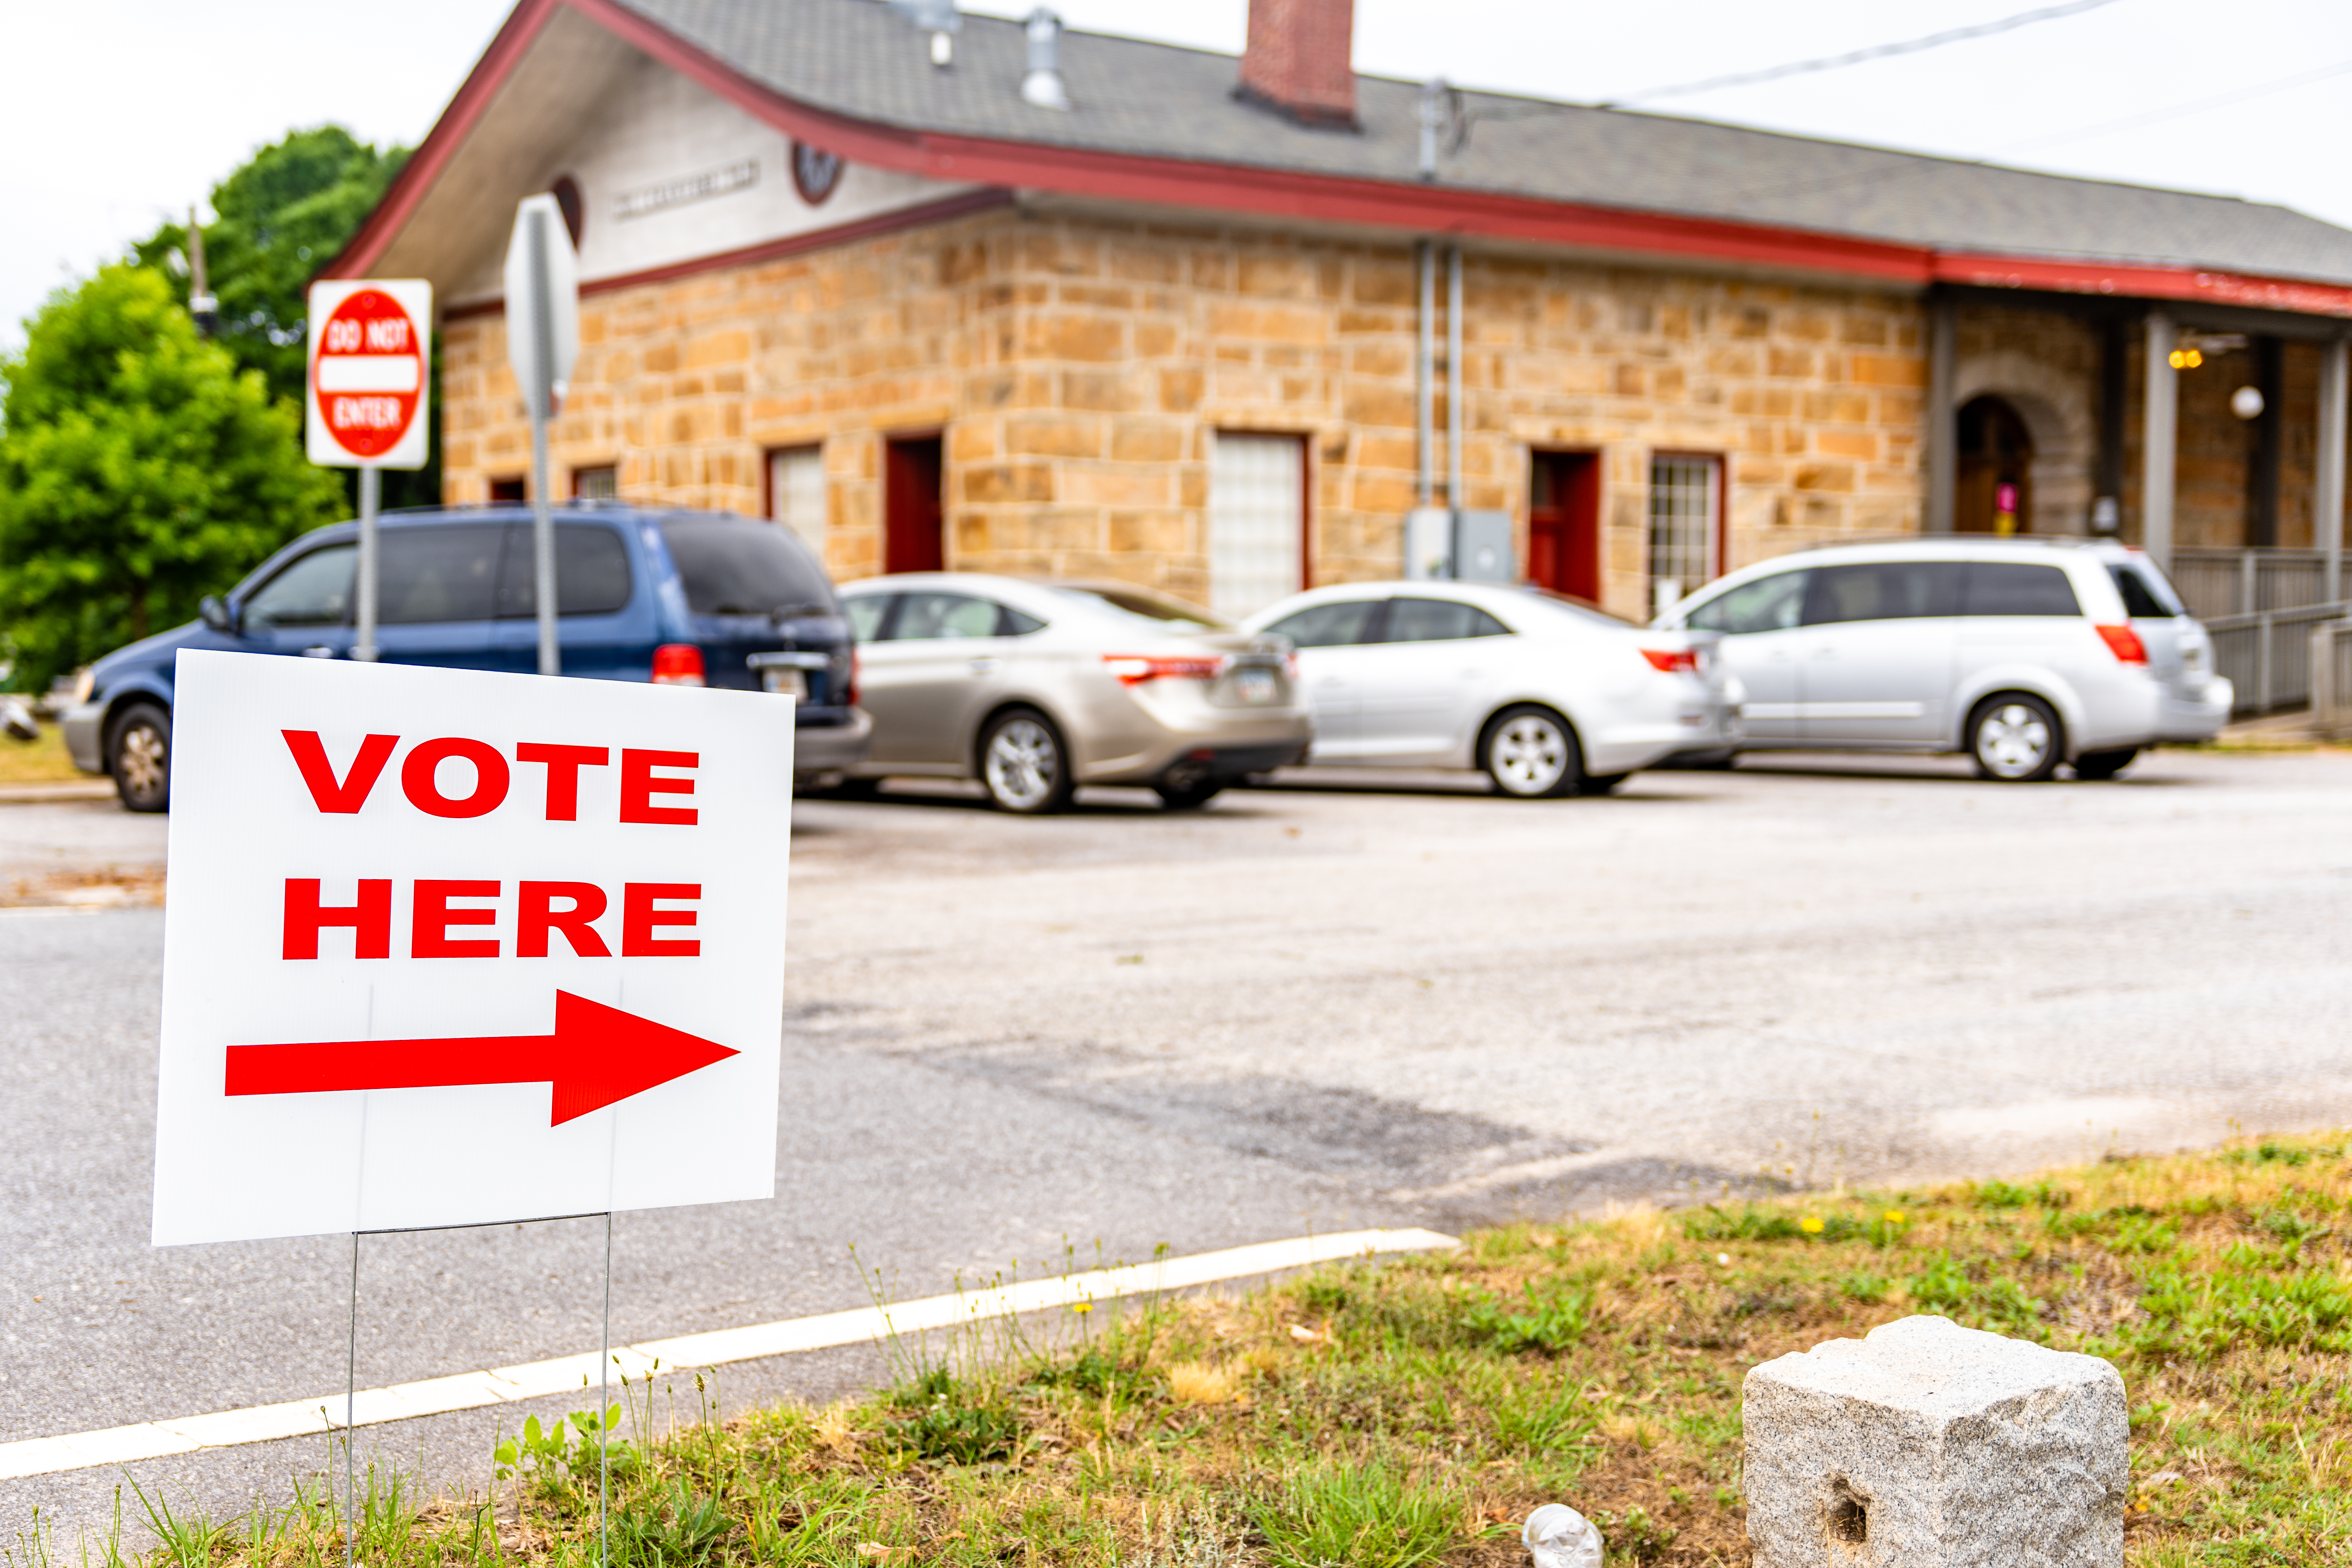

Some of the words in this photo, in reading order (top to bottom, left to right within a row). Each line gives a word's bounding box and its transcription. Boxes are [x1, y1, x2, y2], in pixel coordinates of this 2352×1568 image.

[327, 319, 362, 351] DO
[367, 319, 408, 350] NOT
[333, 398, 401, 428] ENTER
[281, 730, 699, 825] VOTE
[283, 878, 701, 960] HERE
